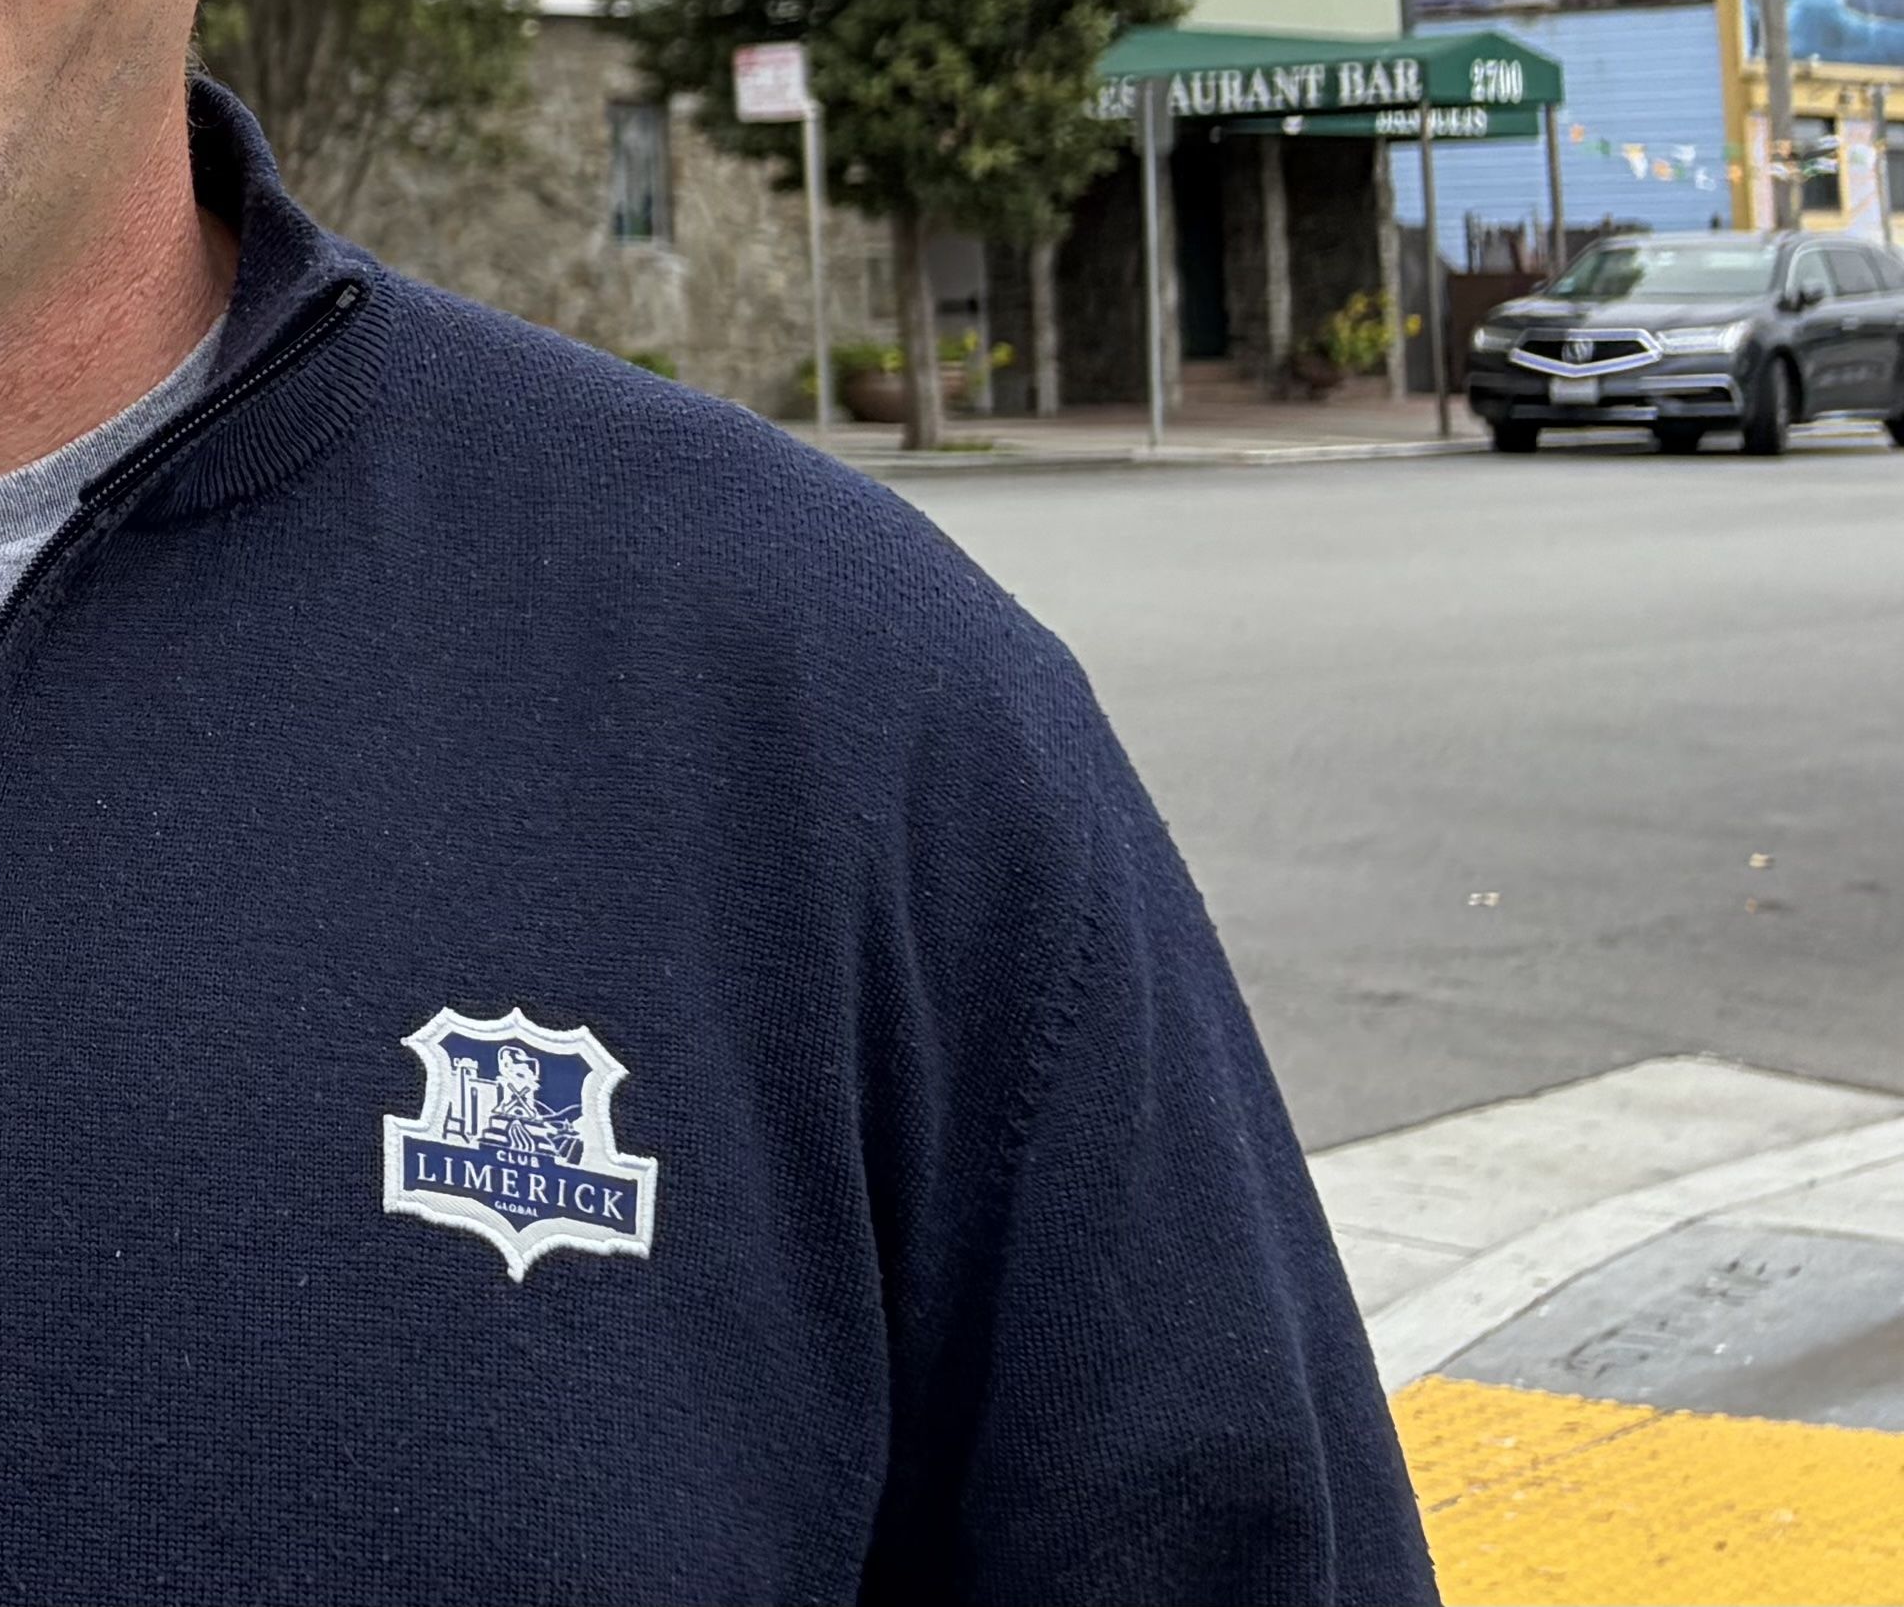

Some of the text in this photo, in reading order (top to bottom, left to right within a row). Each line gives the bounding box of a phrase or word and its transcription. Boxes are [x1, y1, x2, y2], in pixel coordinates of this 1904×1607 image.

[1338, 58, 1424, 106] BAR
[1470, 58, 1524, 104] 2700
[496, 1149, 540, 1168] CLUB
[416, 1152, 624, 1221] LIMERICK
[494, 1200, 539, 1217] GLOBAL
